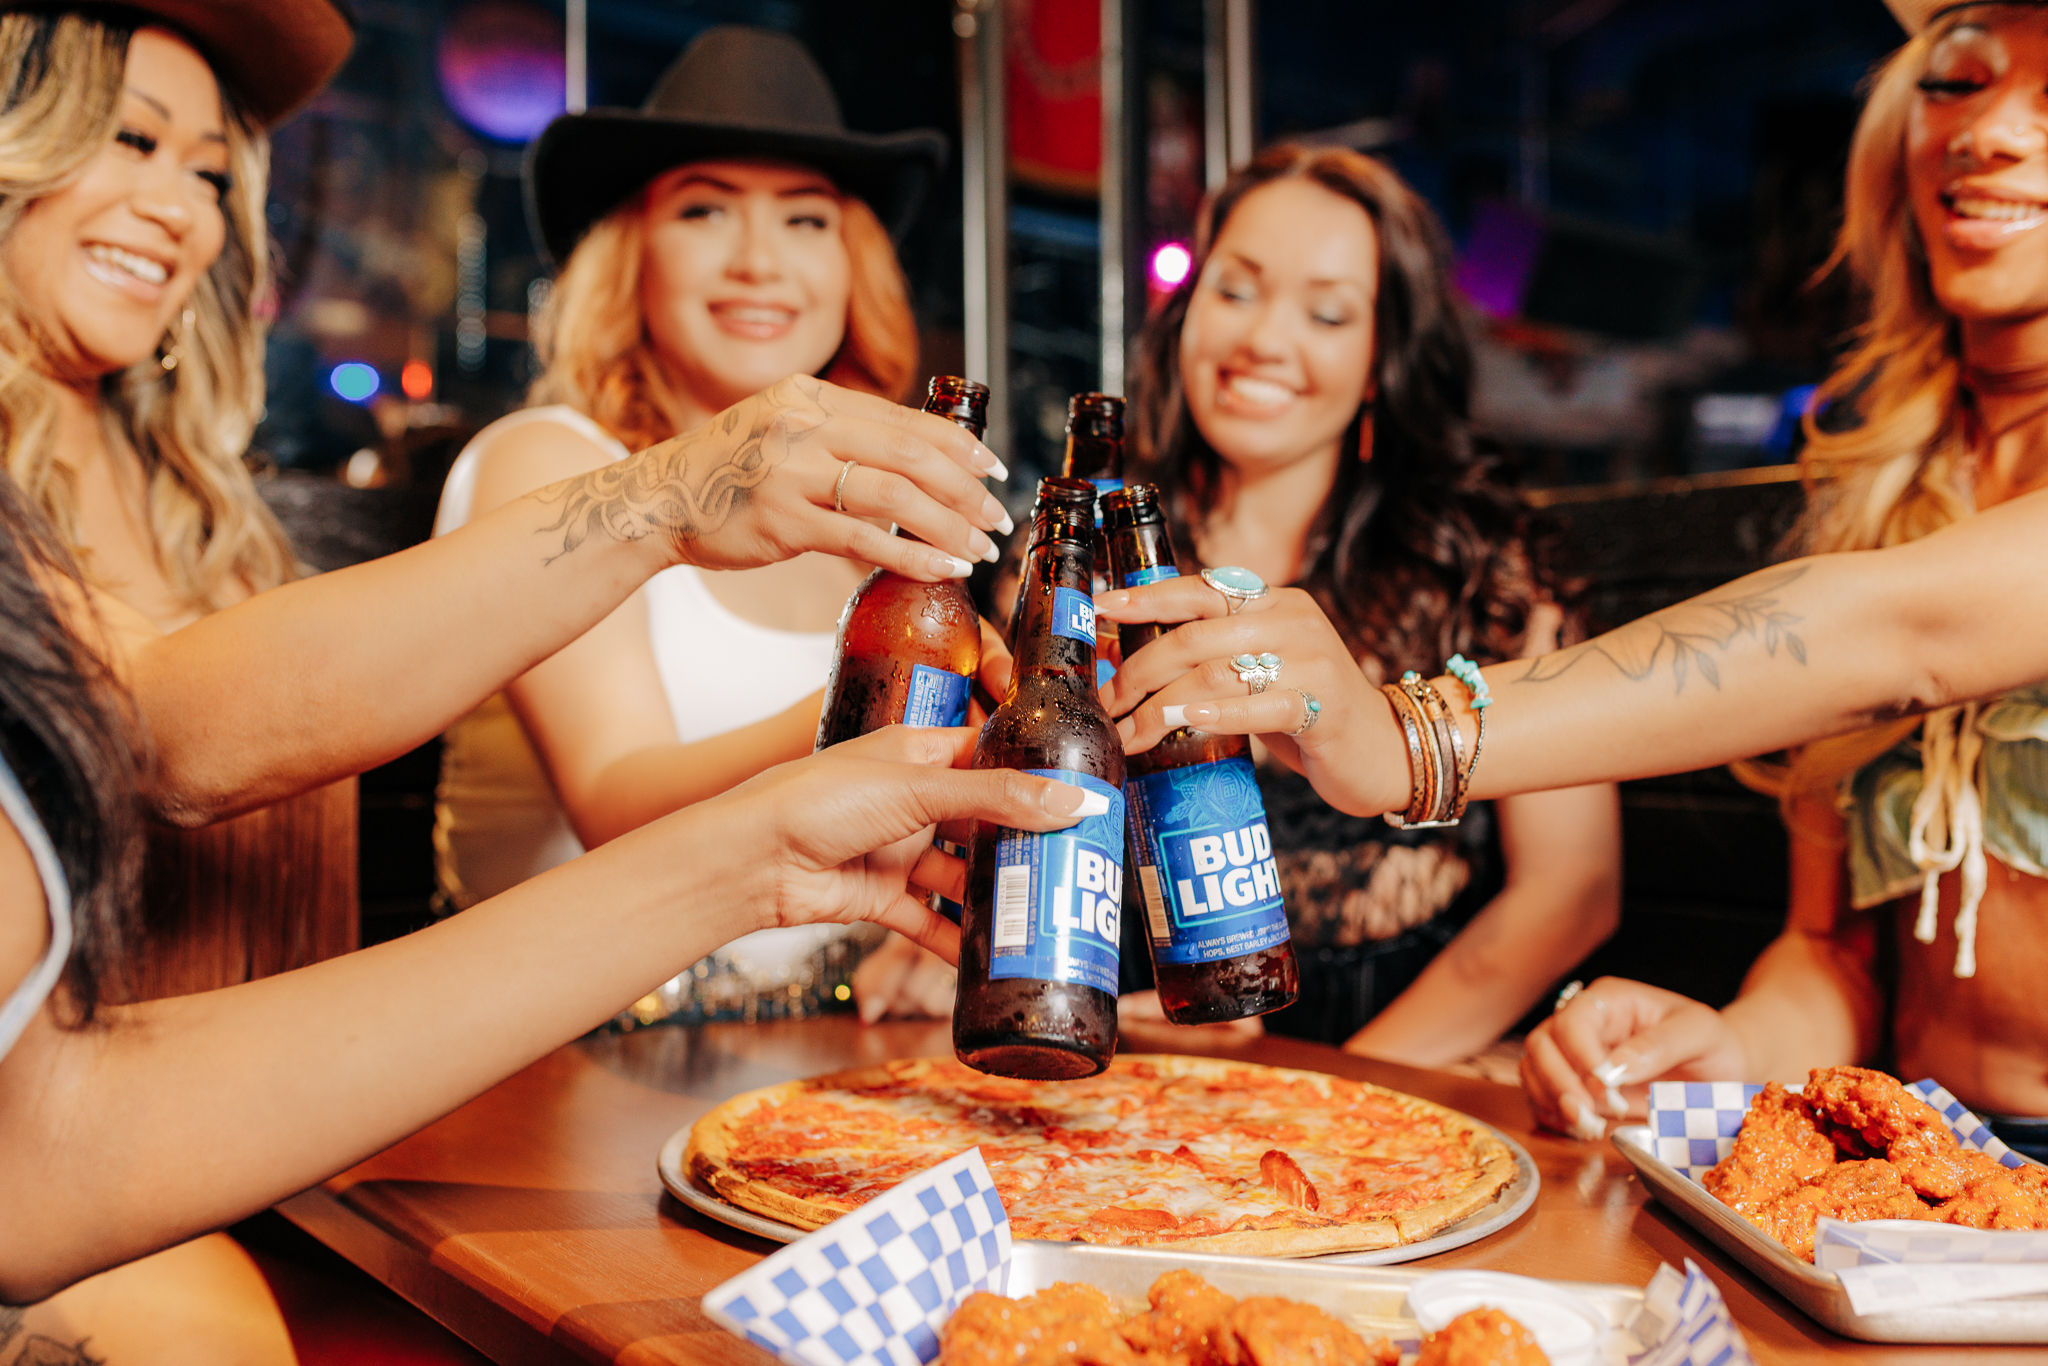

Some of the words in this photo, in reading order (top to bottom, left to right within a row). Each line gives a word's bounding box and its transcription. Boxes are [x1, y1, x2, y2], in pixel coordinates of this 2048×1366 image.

[1189, 823, 1271, 875] BUD
[1077, 848, 1122, 907] BU
[1198, 936, 1226, 949] ALWAYS
[1203, 947, 1226, 959] HOPS,
[1244, 937, 1268, 951] BARLEY
